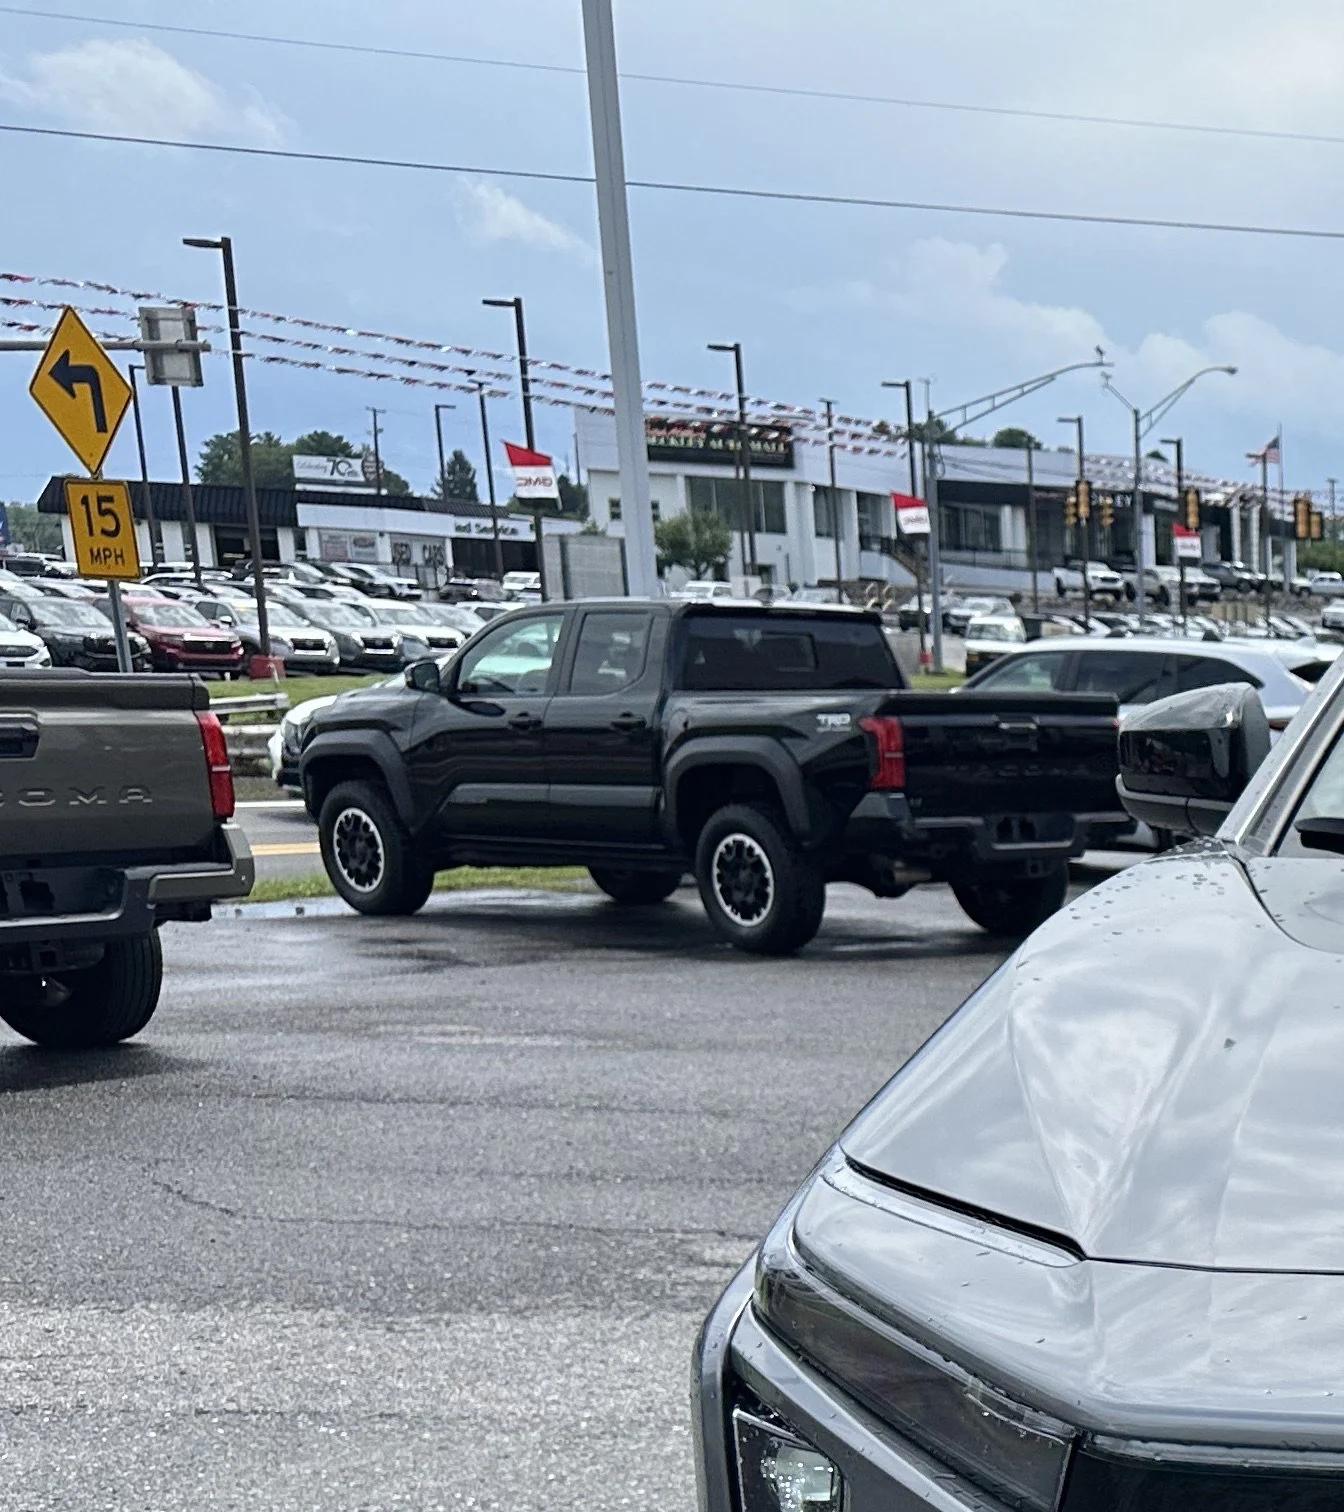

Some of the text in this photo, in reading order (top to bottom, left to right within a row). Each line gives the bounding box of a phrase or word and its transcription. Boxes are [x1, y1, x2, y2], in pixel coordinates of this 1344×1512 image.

[81, 491, 121, 538] 15
[89, 547, 126, 567] MPH
[816, 713, 851, 726] TRD
